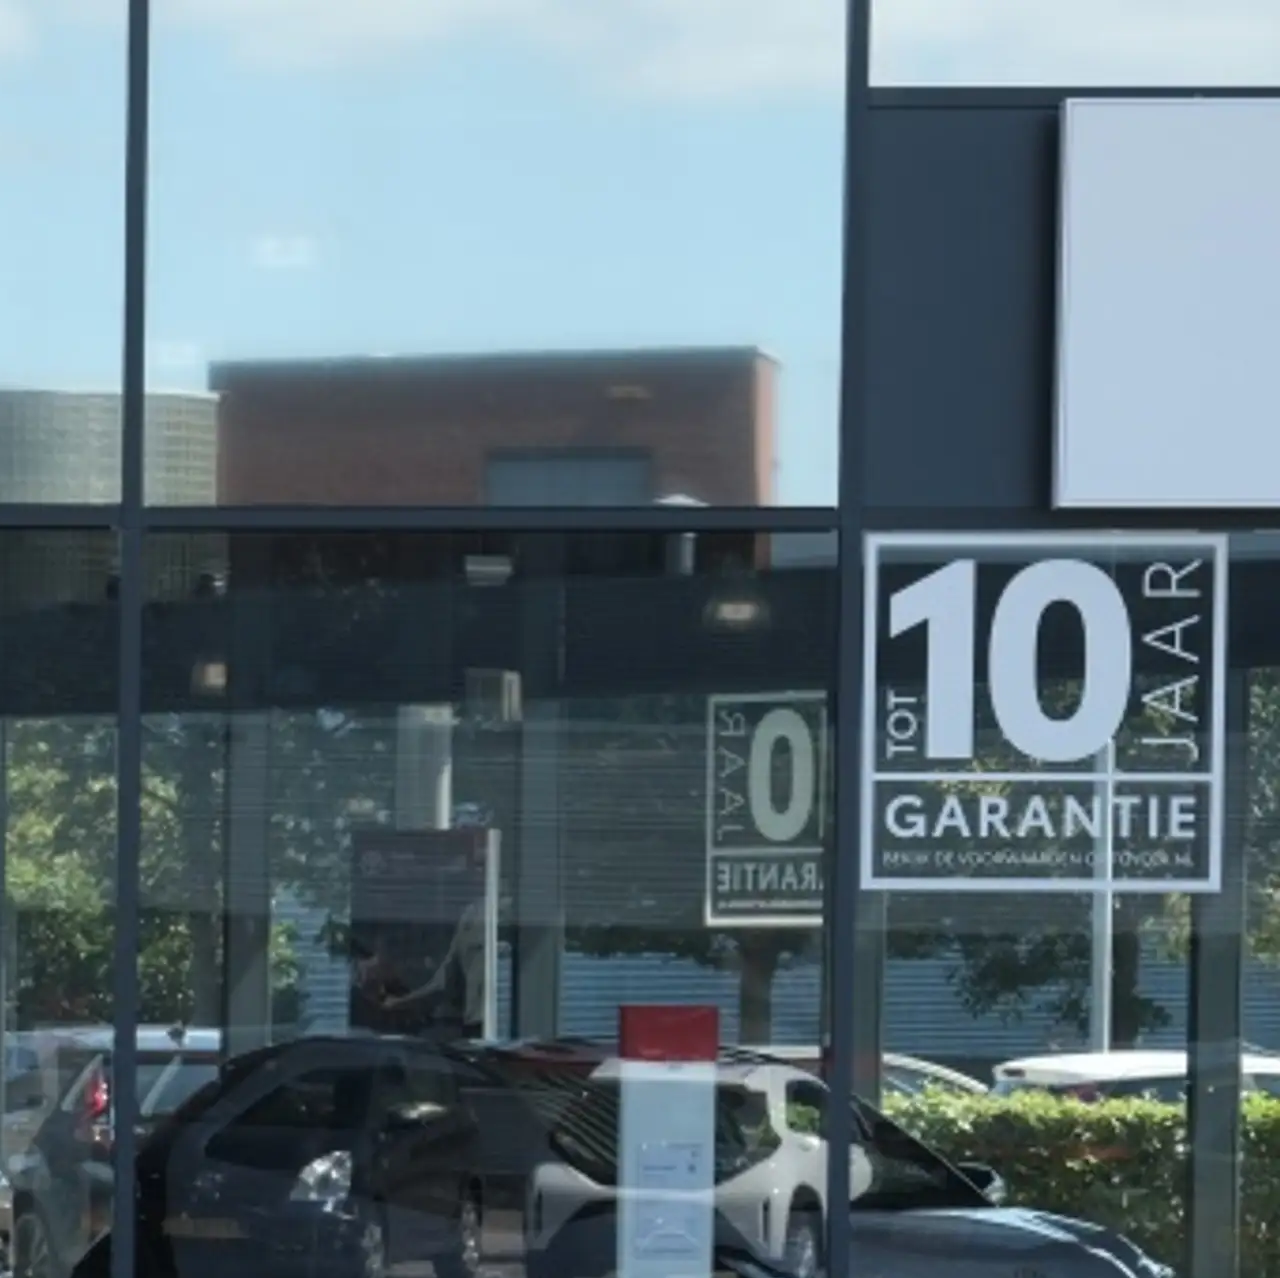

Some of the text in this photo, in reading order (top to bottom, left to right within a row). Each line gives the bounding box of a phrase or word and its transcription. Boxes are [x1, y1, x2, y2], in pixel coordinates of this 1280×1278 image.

[886, 691, 918, 759] TOT
[890, 559, 1131, 762] 10
[1142, 558, 1203, 762] JAAR
[885, 795, 1197, 839] GARANTIE
